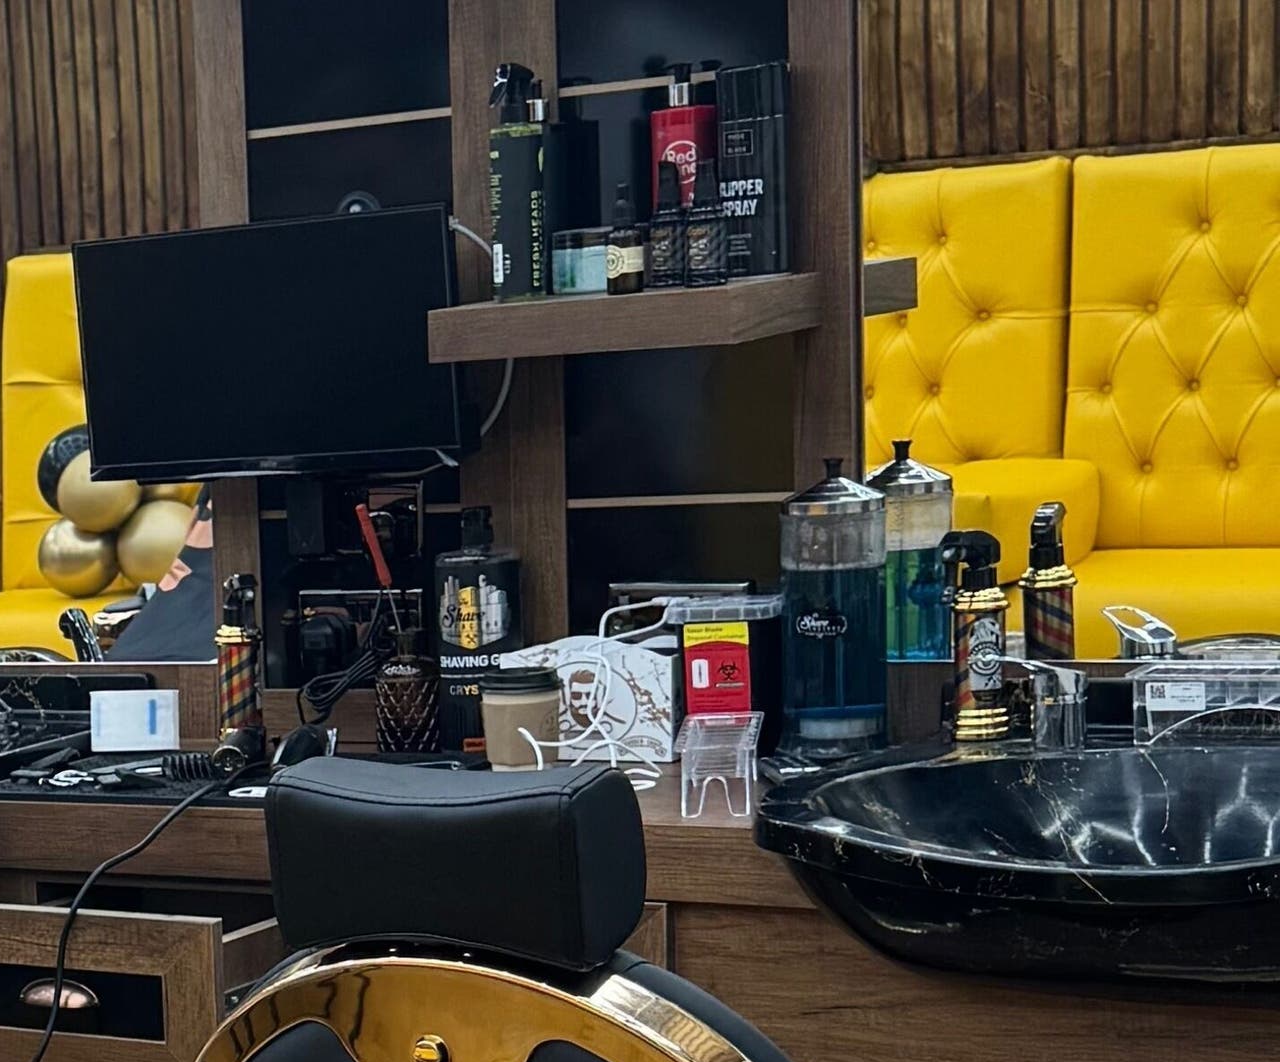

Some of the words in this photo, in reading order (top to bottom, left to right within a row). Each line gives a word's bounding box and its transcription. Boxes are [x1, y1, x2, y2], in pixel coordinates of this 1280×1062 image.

[667, 147, 697, 163] Red
[530, 190, 539, 237] HEADS
[721, 199, 758, 217] SPRAY
[532, 242, 541, 287] FRESH
[440, 653, 489, 669] SHAVING
[449, 684, 479, 696] CRYS
